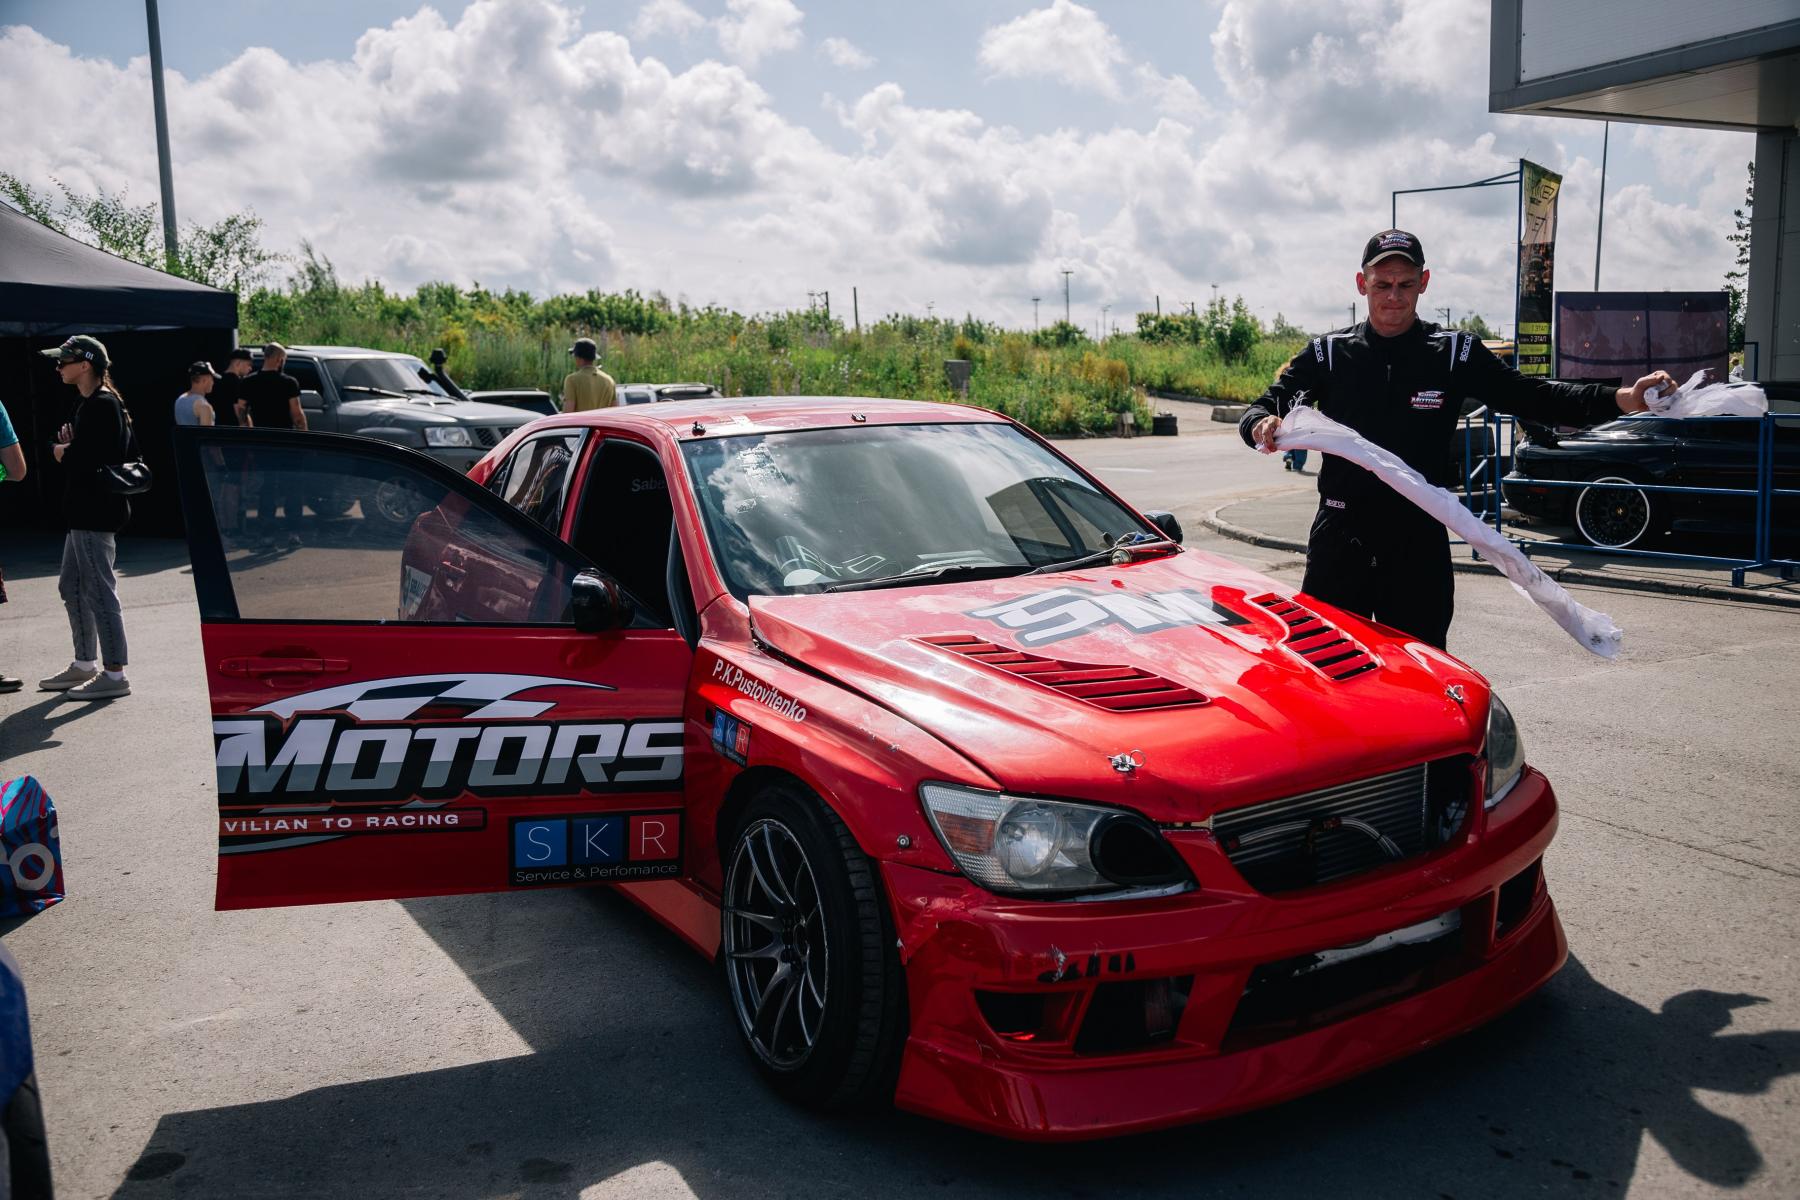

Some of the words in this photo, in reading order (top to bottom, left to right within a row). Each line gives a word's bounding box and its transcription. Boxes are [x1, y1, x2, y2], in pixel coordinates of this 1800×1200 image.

[1460, 335, 1472, 362] sparco
[213, 718, 684, 793] MOTORS
[322, 817, 353, 829] TO
[366, 814, 460, 827] RACING
[516, 869, 570, 882] Service
[573, 867, 586, 879] &
